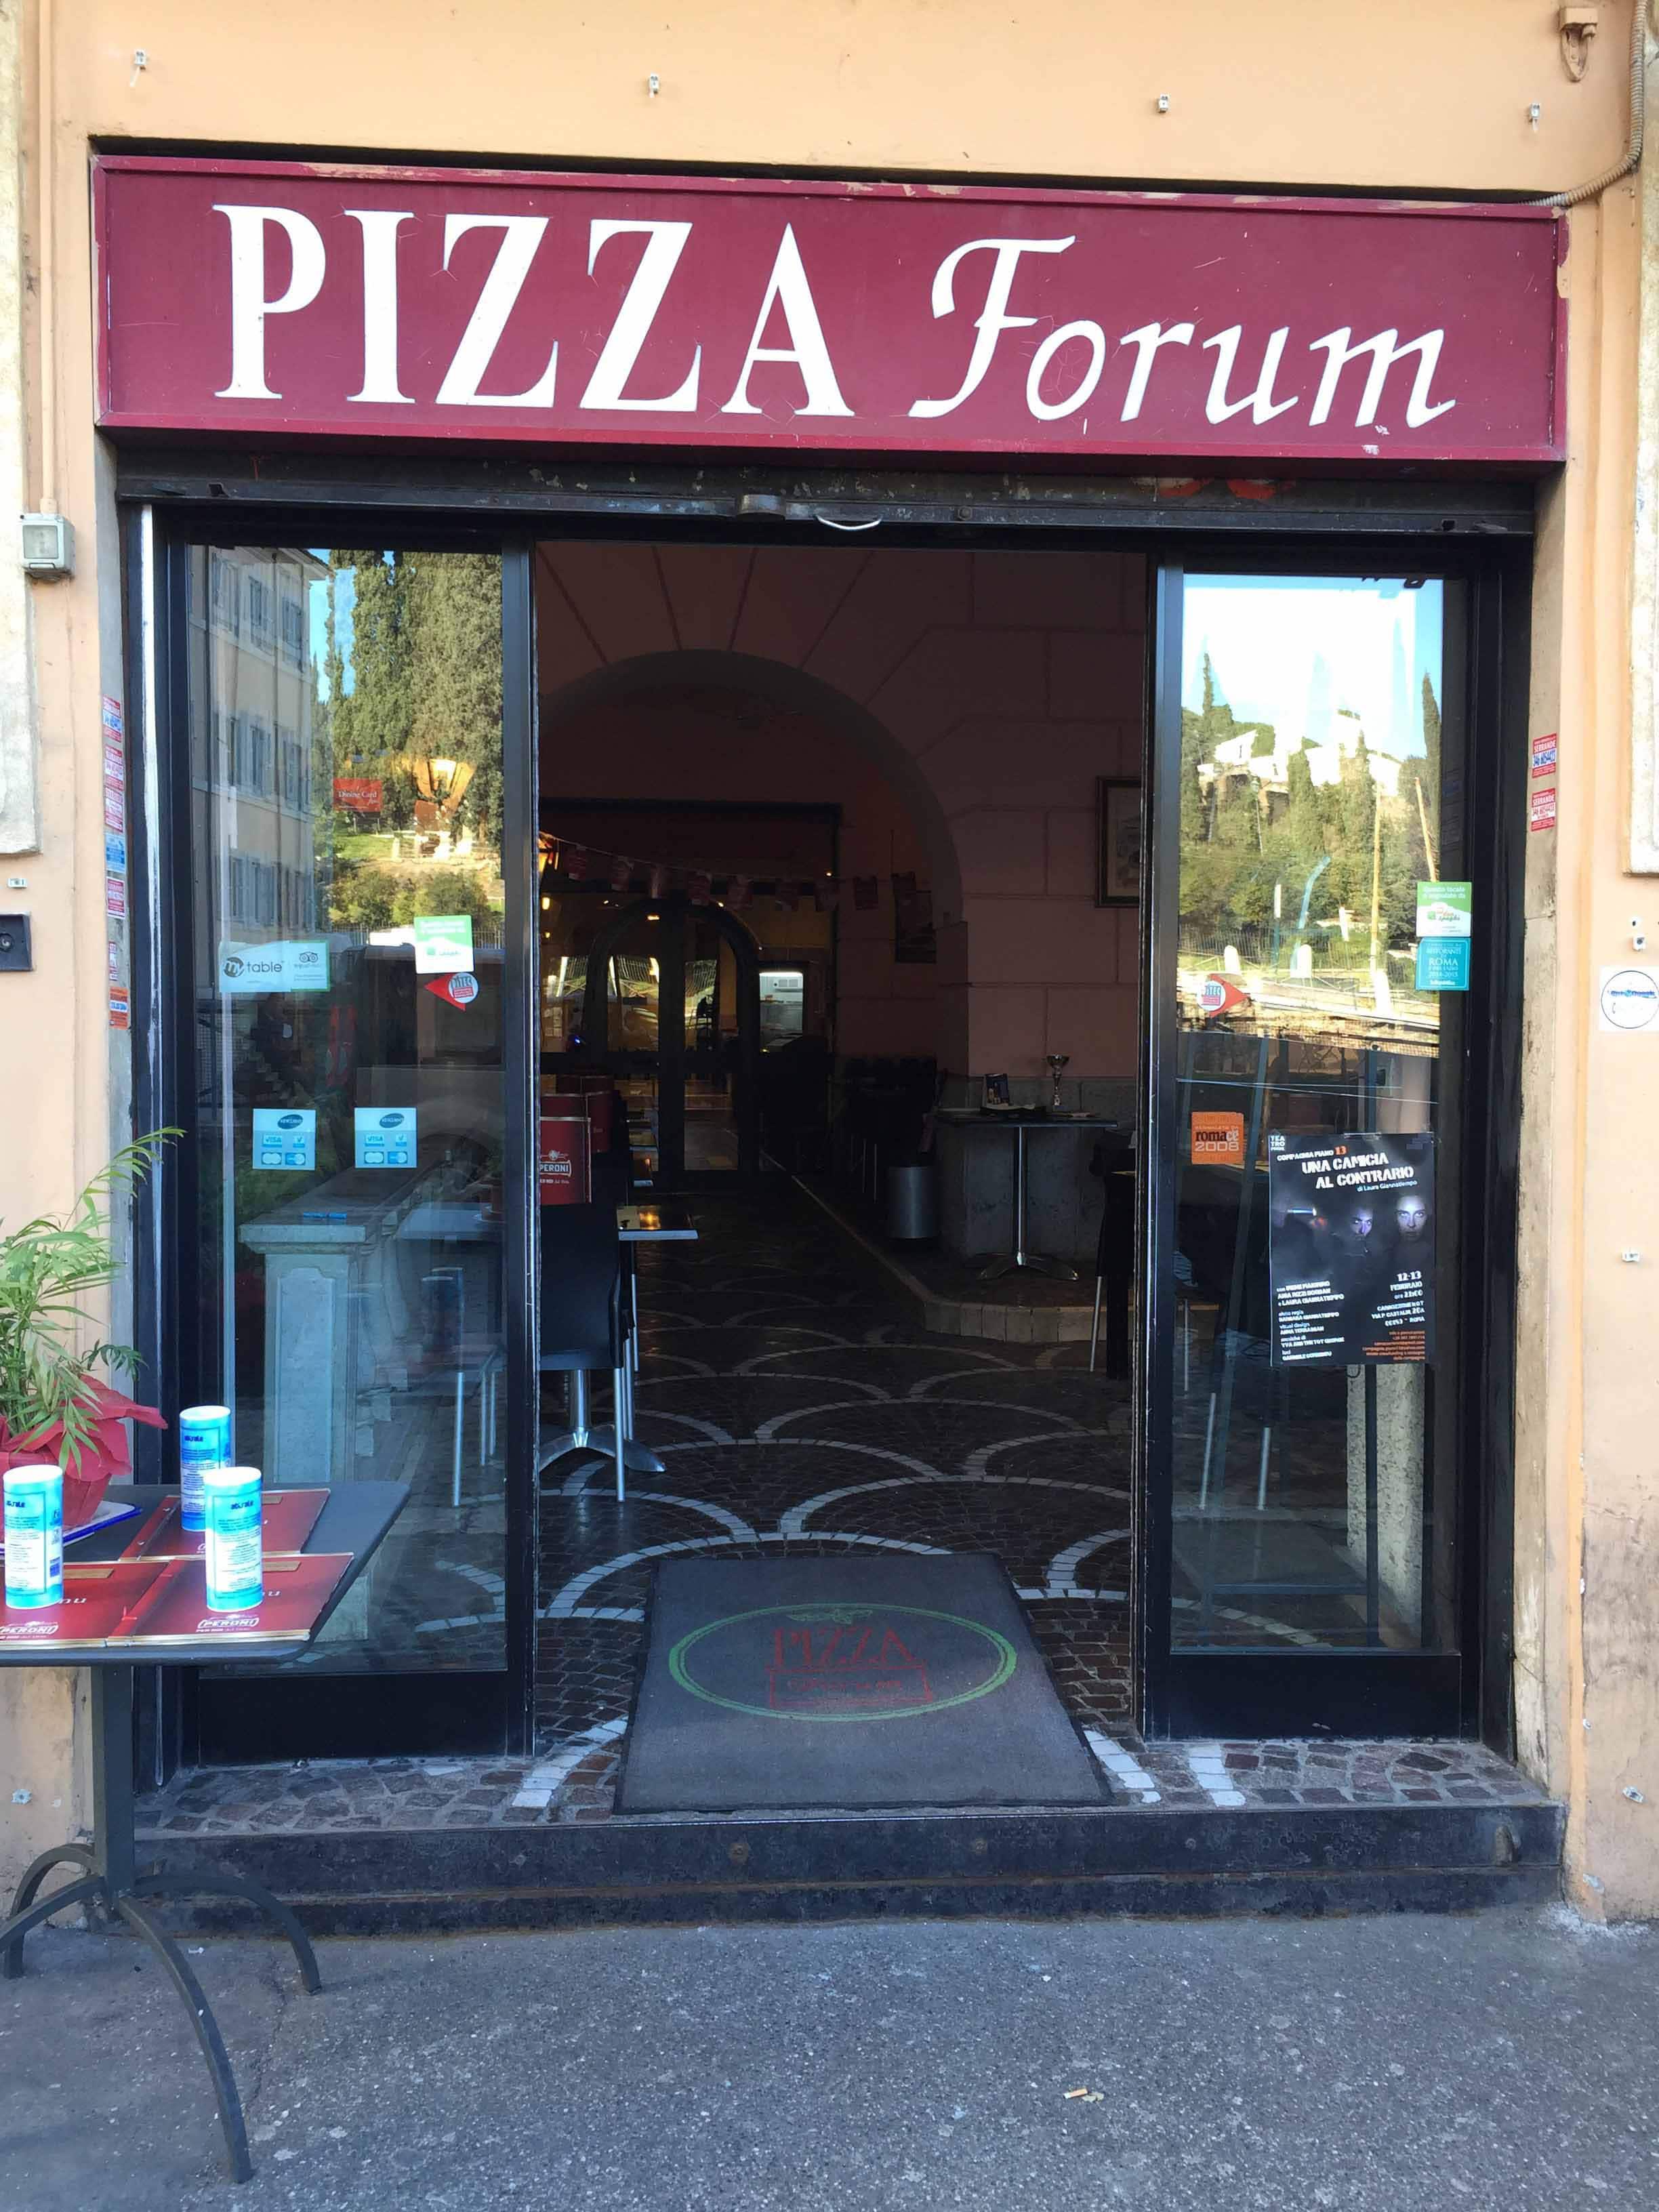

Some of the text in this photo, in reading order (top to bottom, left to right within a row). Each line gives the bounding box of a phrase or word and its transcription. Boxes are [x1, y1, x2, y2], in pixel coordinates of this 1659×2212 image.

[212, 203, 1456, 428] PIZZA Forum
[1429, 958, 1458, 966] ROMA
[1195, 1141, 1240, 1151] 2008
[1334, 1145, 1347, 1155] 13
[540, 1164, 569, 1172] PERONI
[1301, 1152, 1389, 1174] UNA CAMICIA
[1315, 1166, 1414, 1189] AL CONTRARIO
[771, 1626, 918, 1666] PIZZA
